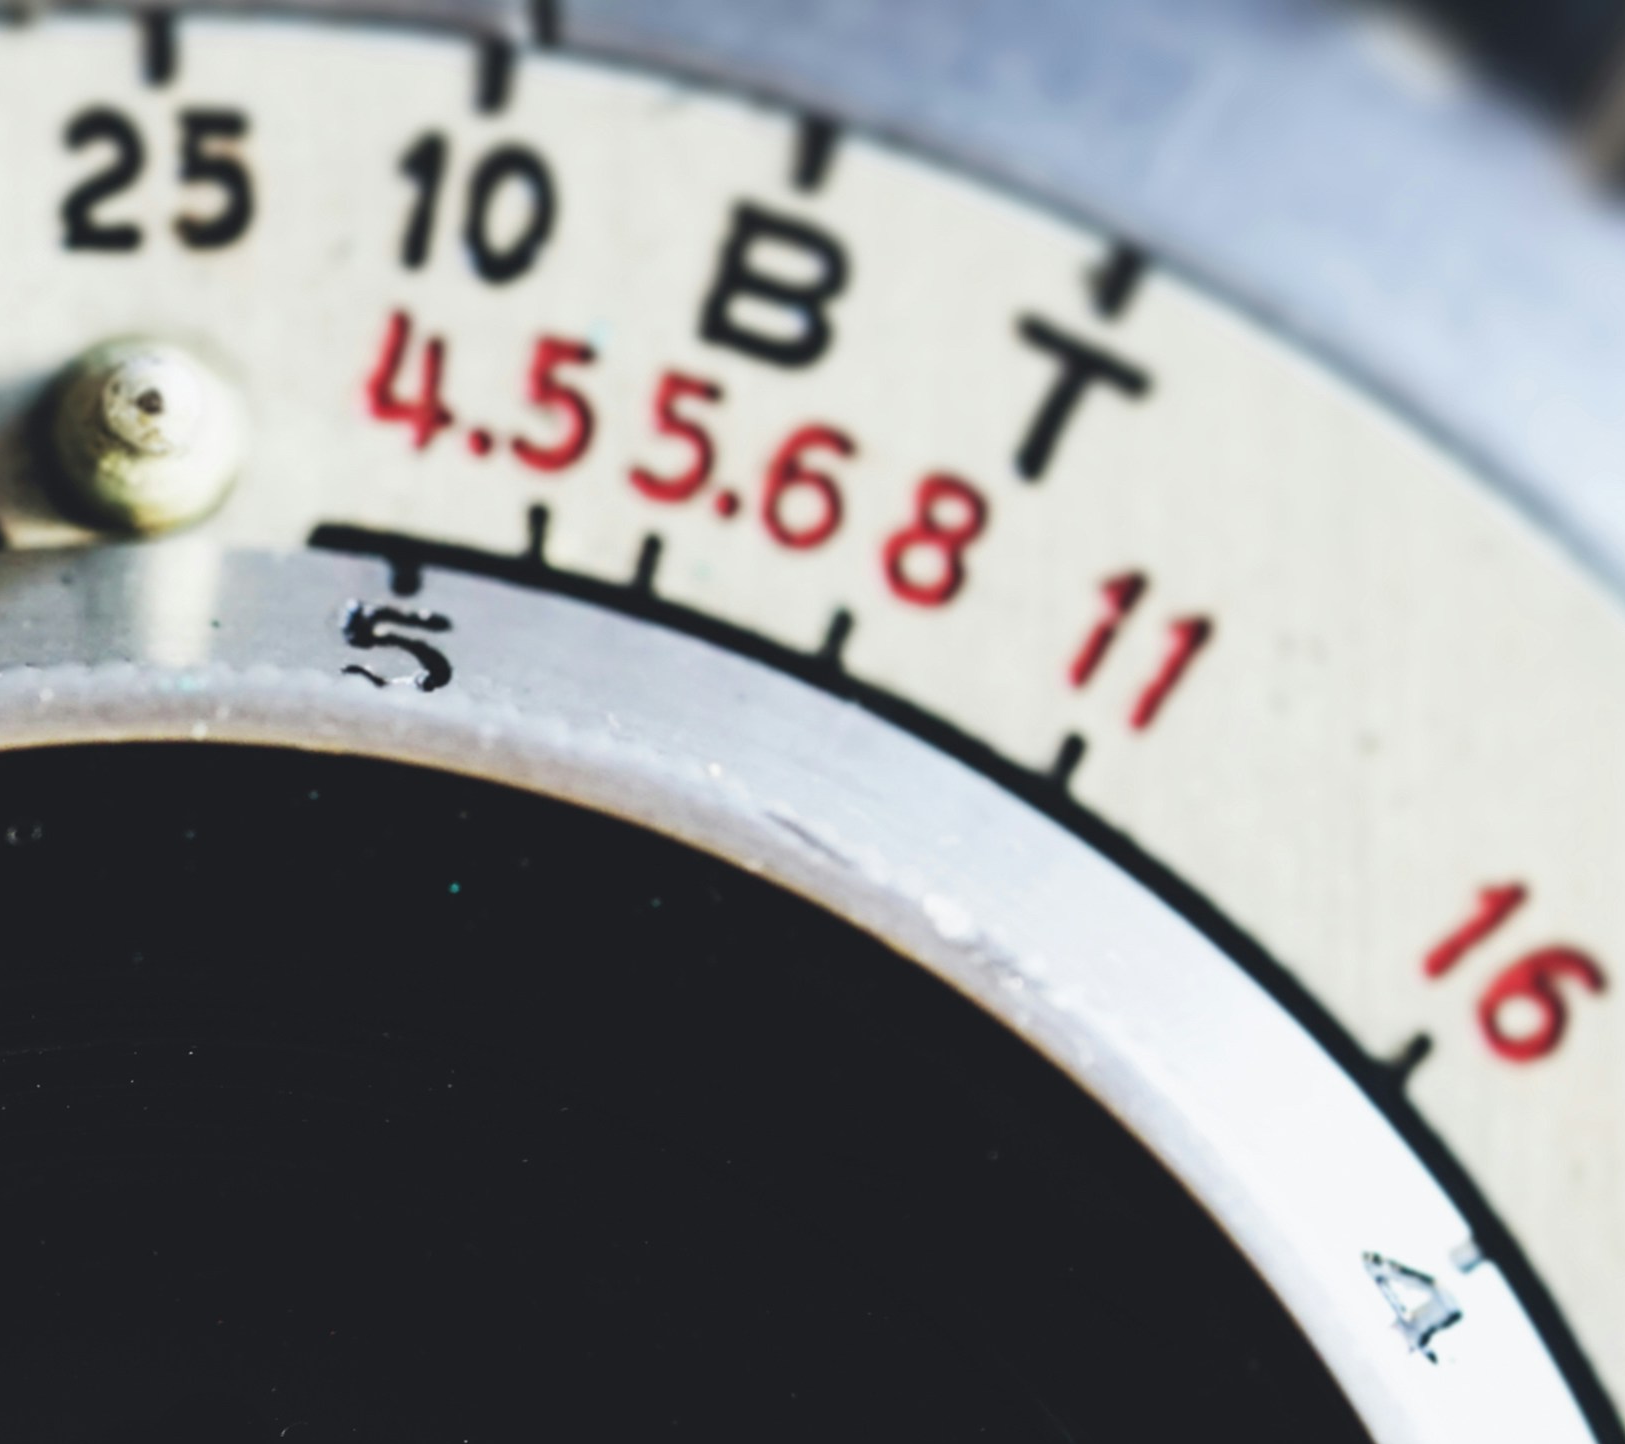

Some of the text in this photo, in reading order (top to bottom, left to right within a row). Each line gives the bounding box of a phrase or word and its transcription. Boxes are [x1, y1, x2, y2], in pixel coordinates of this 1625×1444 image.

[60, 107, 256, 253] 25
[396, 131, 558, 286] 10
[700, 202, 852, 370] B
[363, 309, 600, 473] 4.5
[628, 371, 858, 552] 5.6
[1015, 314, 1155, 483] T
[879, 473, 989, 610] 8
[340, 600, 455, 694] 5
[1068, 571, 1214, 731] 11
[1420, 880, 1609, 1064] 16
[1360, 1249, 1463, 1366] 4
